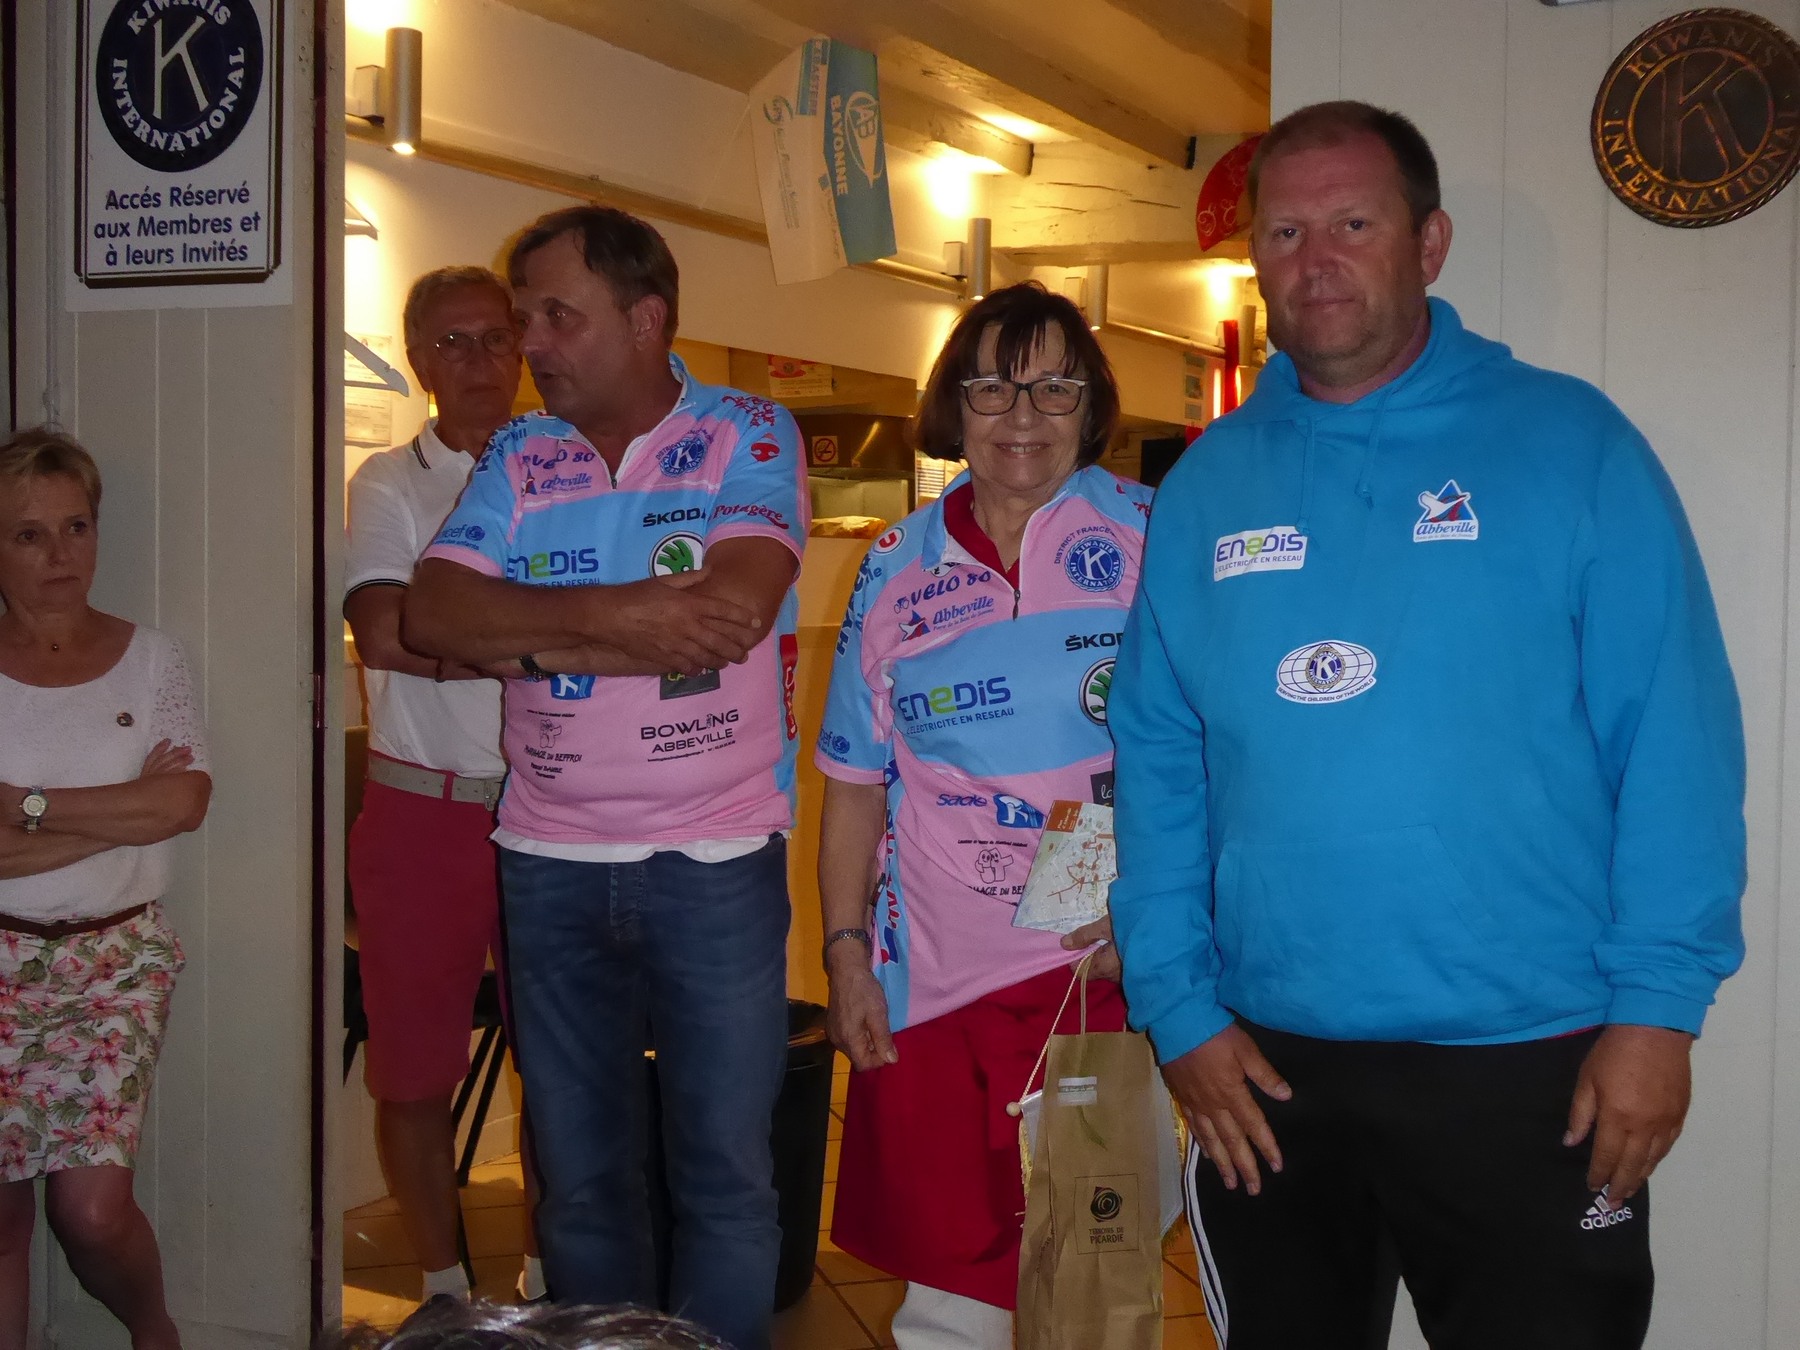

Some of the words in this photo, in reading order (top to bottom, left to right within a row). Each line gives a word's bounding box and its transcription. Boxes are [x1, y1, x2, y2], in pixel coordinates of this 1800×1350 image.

[153, 16, 209, 119] K
[112, 47, 245, 151] INTERNATIONAL
[1660, 52, 1753, 182] K
[829, 94, 849, 197] BAYONNE
[105, 186, 161, 210] Accés
[169, 181, 250, 208] Réservé
[94, 223, 131, 239] aux
[137, 213, 232, 237] Membres
[240, 211, 261, 232] et
[105, 244, 118, 267] à
[126, 244, 174, 265] leurs
[182, 239, 248, 263] Invités
[572, 451, 596, 463] 80
[712, 504, 785, 522] Potagère
[1054, 532, 1077, 565] DISTRICT
[1076, 526, 1110, 536] FRANCE
[1075, 540, 1115, 555] KIWANIS
[1083, 547, 1109, 579] K
[966, 570, 991, 586] 80
[1065, 632, 1123, 652] ŠKO
[1315, 656, 1335, 680] K
[1278, 687, 1296, 700] SERVING
[1344, 689, 1356, 697] THE
[1356, 678, 1374, 693] WORLD
[641, 709, 739, 740] BOWLING
[960, 715, 972, 724] EN
[975, 707, 1014, 721] RESEAU
[651, 728, 733, 754] ABBEVILLE
[1580, 1206, 1633, 1230] adidas
[1090, 1233, 1124, 1245] PICARDIE
